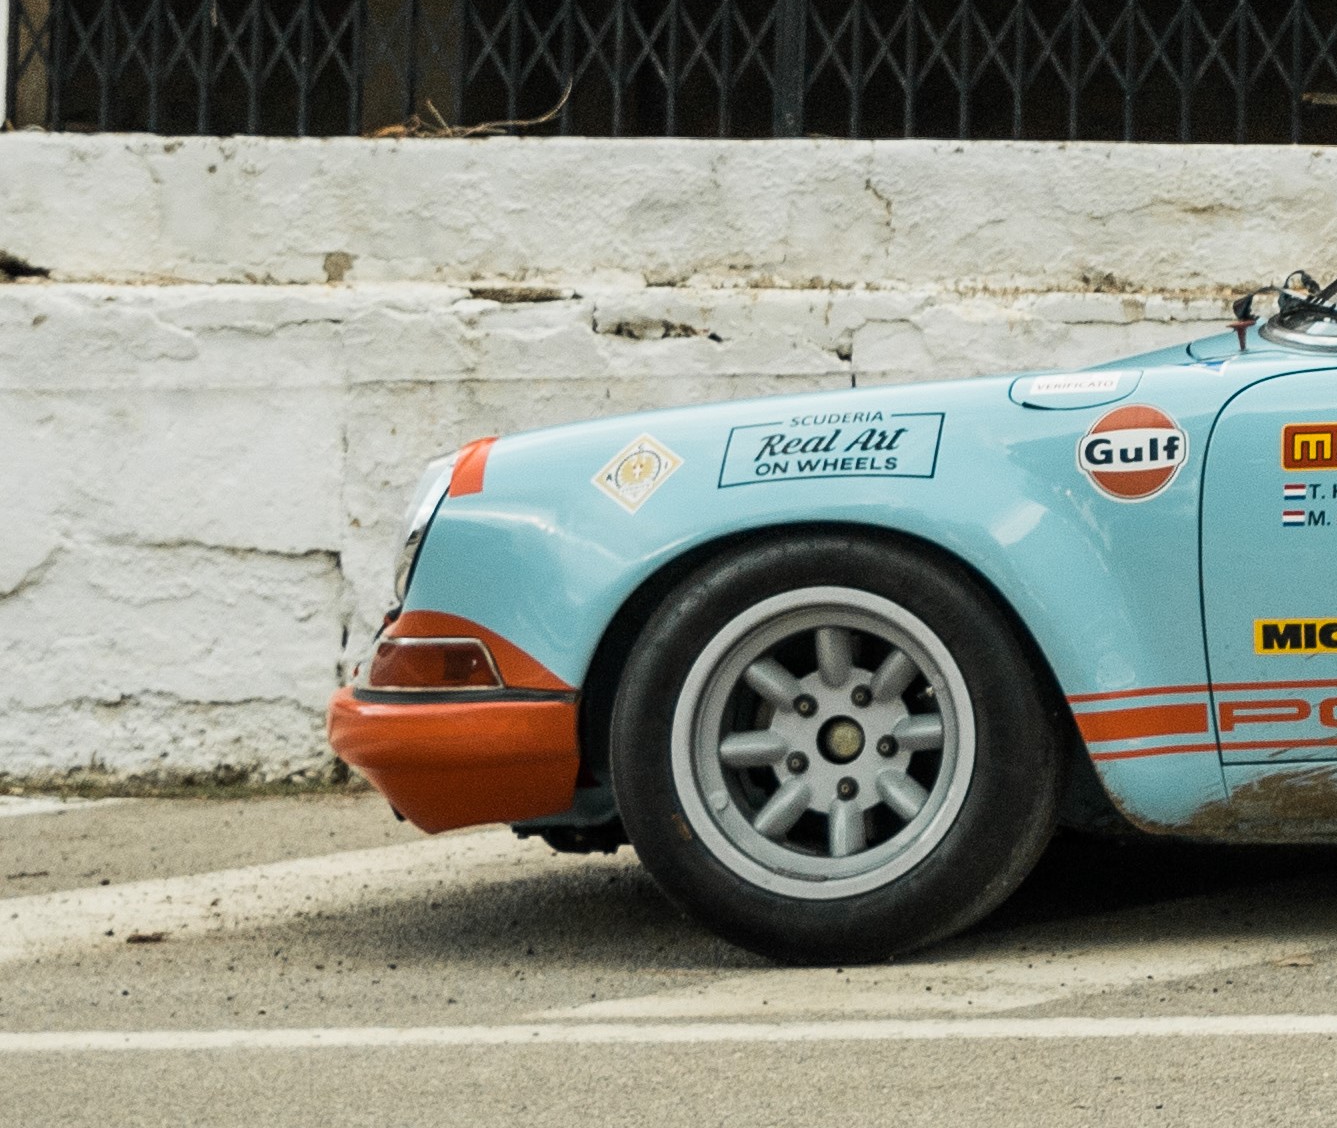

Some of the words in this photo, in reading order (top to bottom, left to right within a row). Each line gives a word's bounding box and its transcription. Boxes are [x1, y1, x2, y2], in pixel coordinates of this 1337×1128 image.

[1036, 379, 1115, 392] VERIFICATO
[790, 410, 885, 427] SCUDERIA
[754, 429, 842, 462] Real
[844, 427, 909, 453] Art
[1084, 435, 1181, 466] Gulf
[755, 461, 790, 477] ON
[797, 456, 899, 473] WHEELS
[1308, 483, 1326, 500] T.
[1307, 509, 1331, 527] M.
